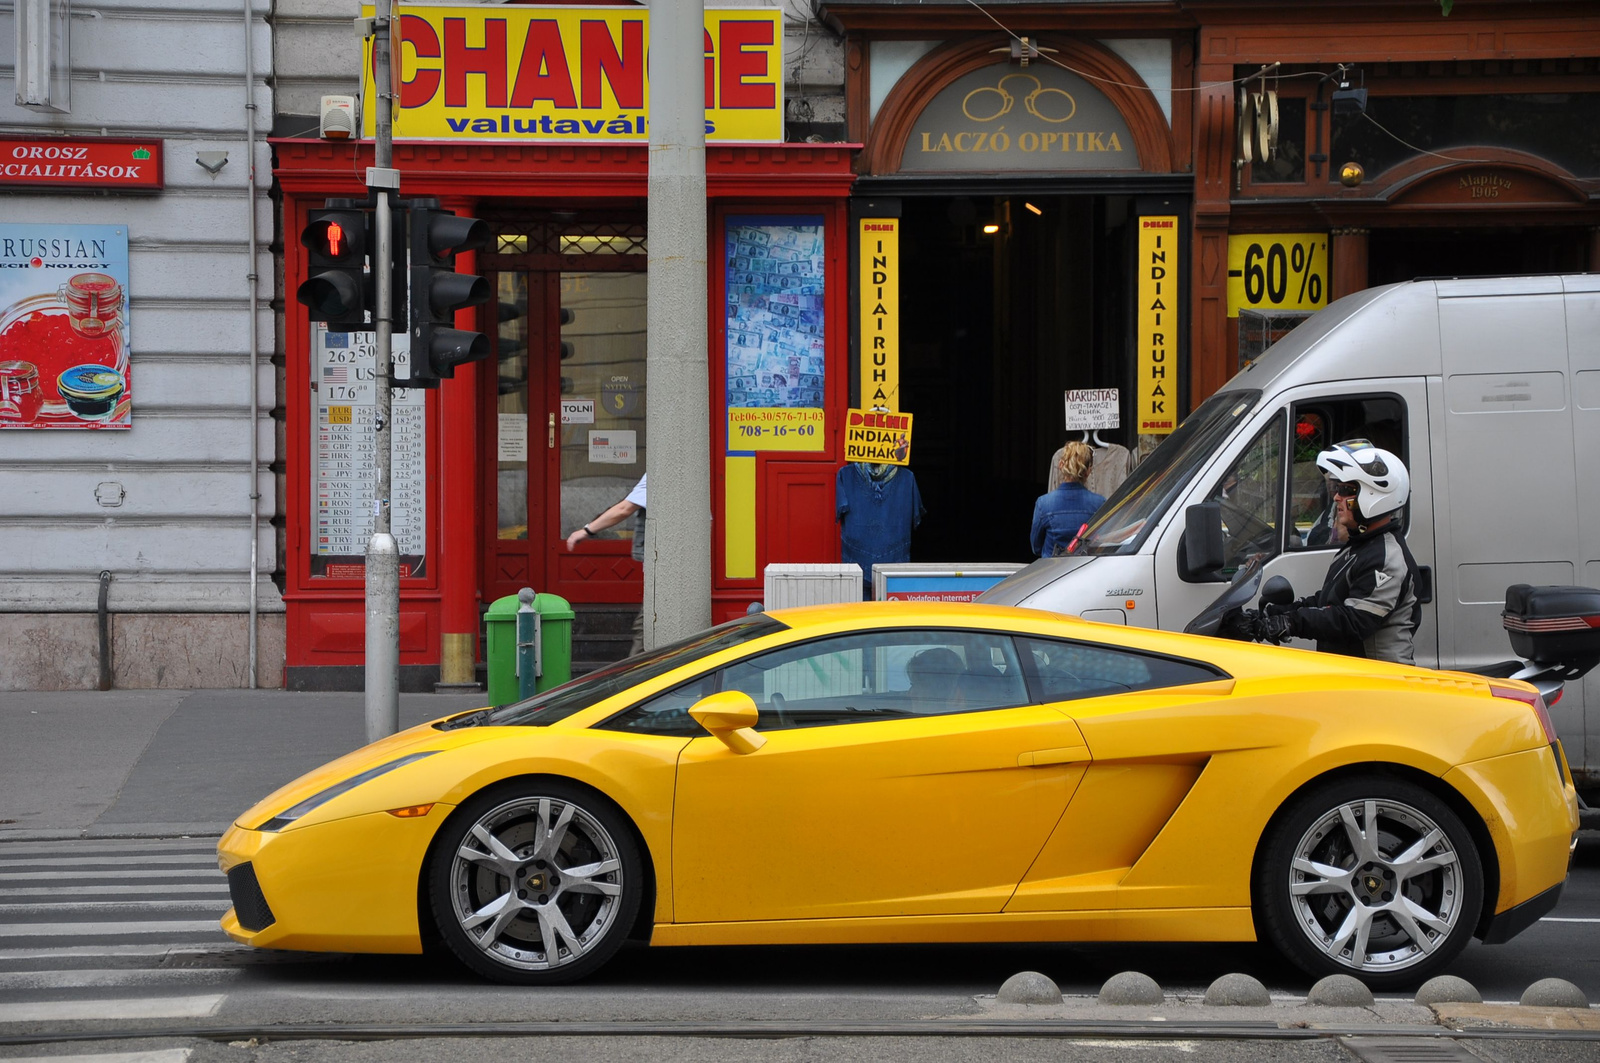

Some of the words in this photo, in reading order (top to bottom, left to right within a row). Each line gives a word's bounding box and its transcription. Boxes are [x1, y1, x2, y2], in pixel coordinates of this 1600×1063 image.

[372, 14, 776, 109] CHANE
[446, 114, 716, 134] valutavál
[921, 126, 1010, 152] LACZÓ
[1018, 132, 1123, 152] OPTIKA
[12, 146, 88, 159] OROSZ
[0, 163, 141, 178] CIALITÁSOK
[1472, 186, 1499, 198] 1905
[3, 238, 106, 258] RUSSIAN
[872, 240, 888, 331] INDIAI
[1150, 235, 1166, 326] INDIAI
[355, 367, 375, 380] US
[1151, 333, 1166, 414] RUHÁK
[850, 412, 909, 430] DELHI
[849, 430, 897, 444] INDIAI
[848, 444, 895, 459] RUHÁK
[907, 594, 940, 602] Vodafone
[941, 594, 970, 602] Internet
